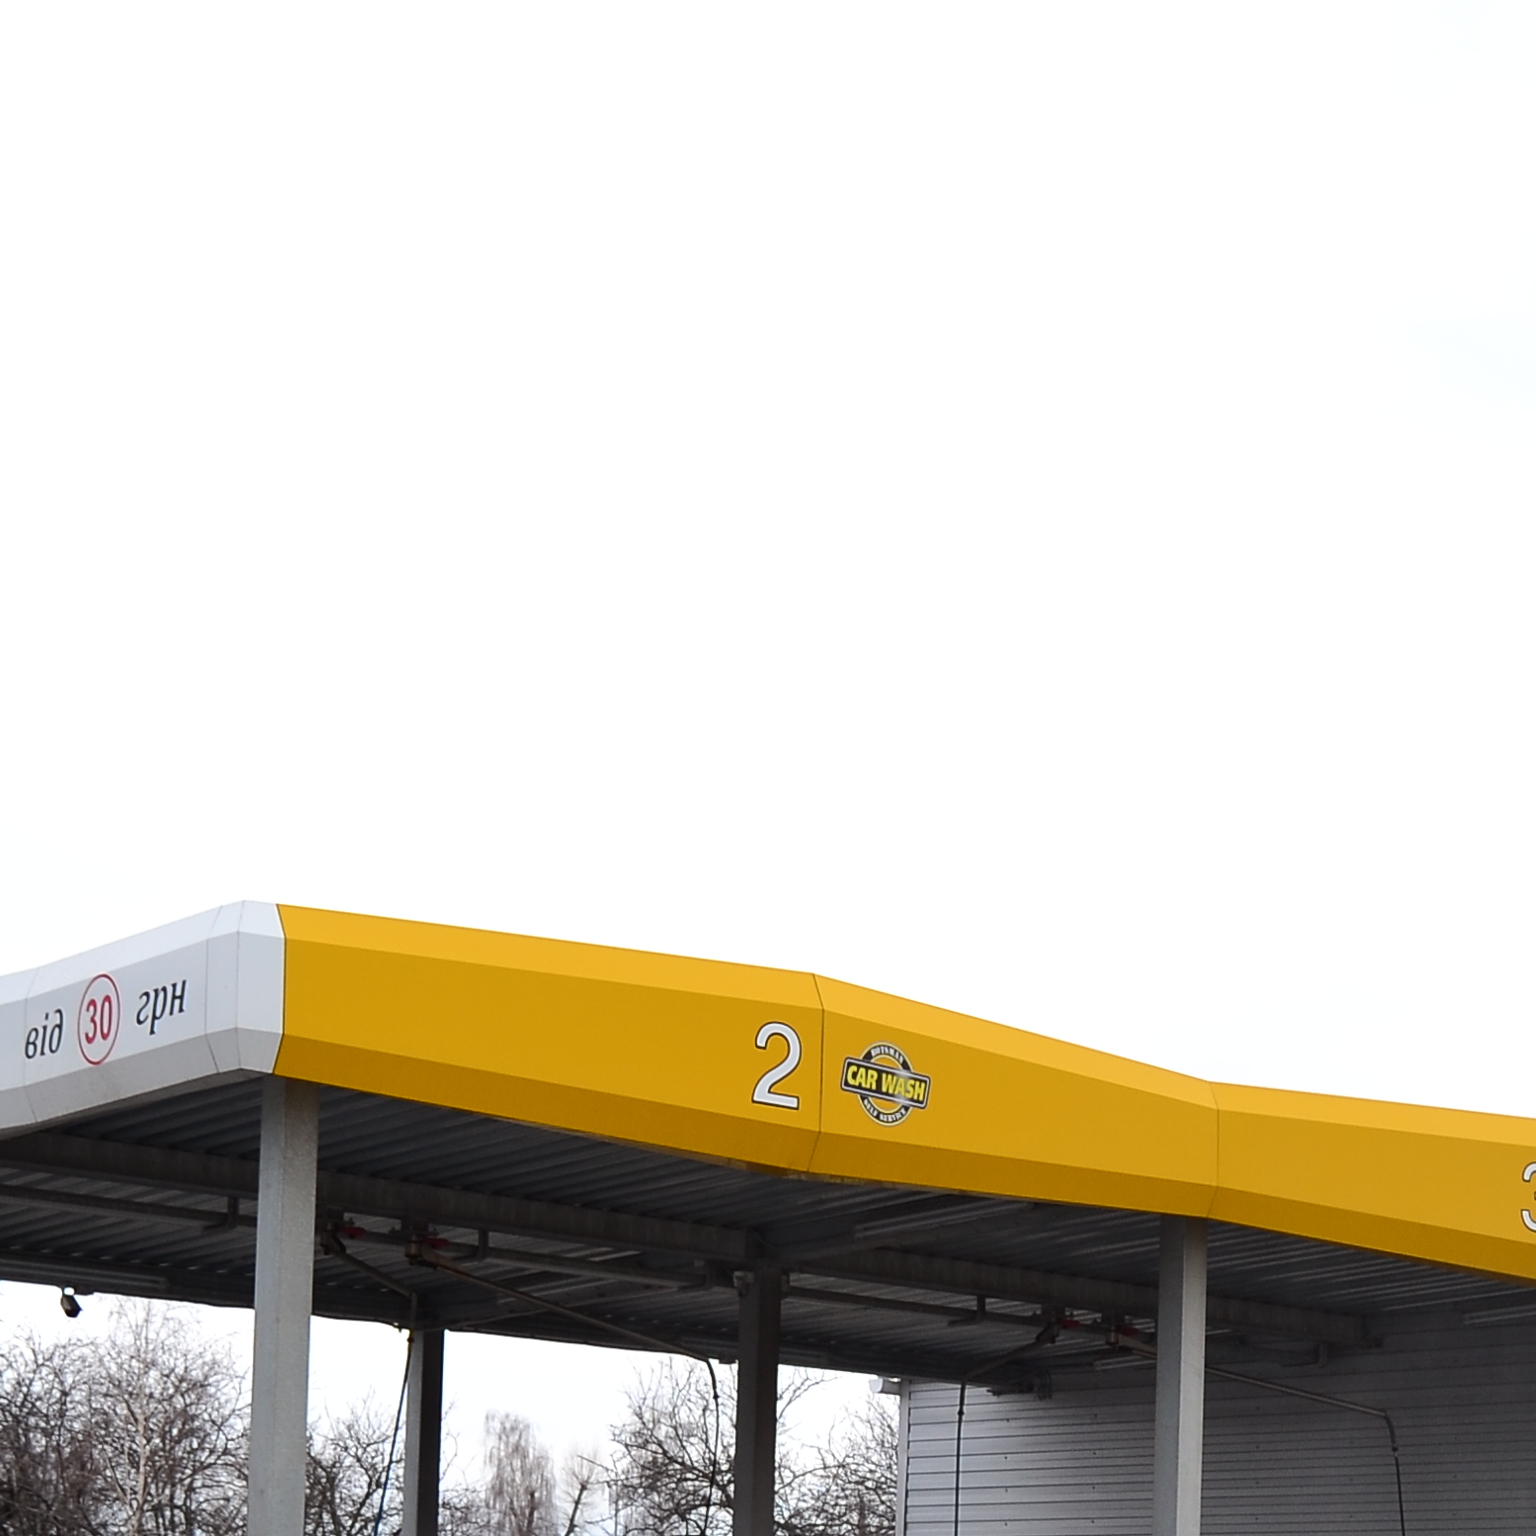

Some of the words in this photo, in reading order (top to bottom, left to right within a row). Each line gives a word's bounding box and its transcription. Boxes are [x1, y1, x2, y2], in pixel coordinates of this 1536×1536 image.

[25, 1008, 64, 1059] від
[85, 995, 113, 1044] 30
[136, 979, 187, 1035] грн
[752, 1021, 802, 1110] 2
[847, 1065, 878, 1091] CAR
[881, 1072, 926, 1101] WASH
